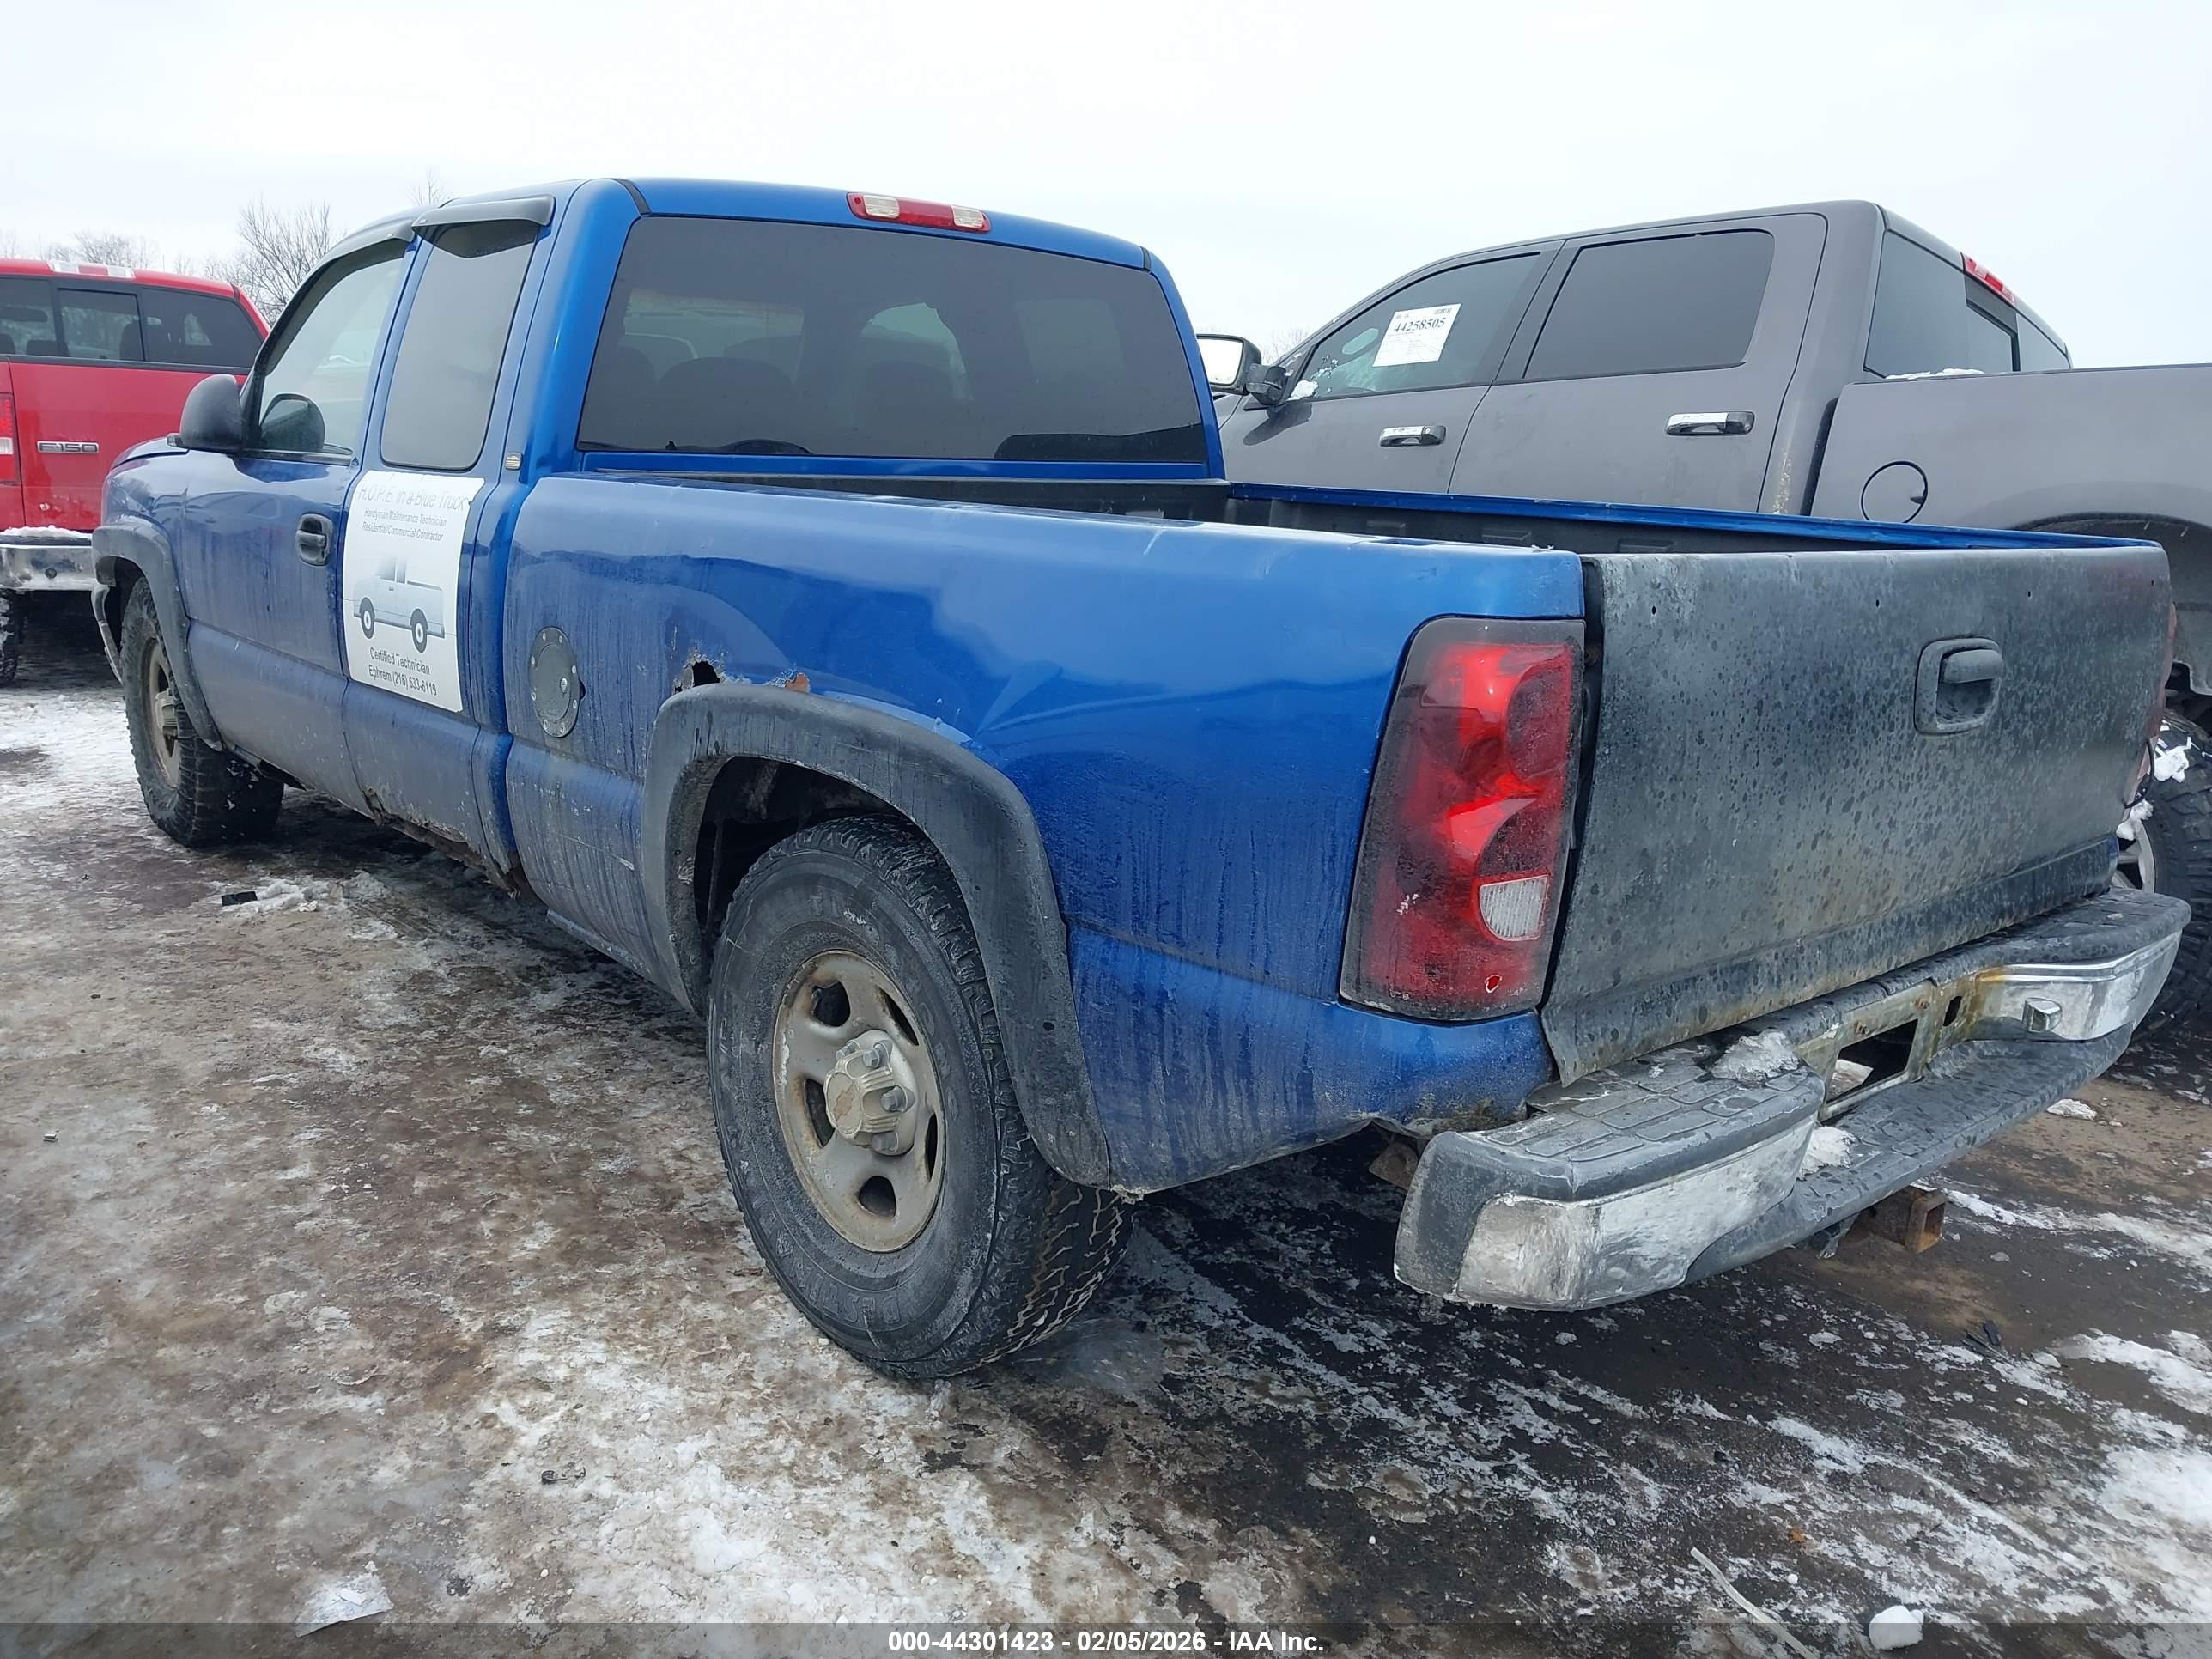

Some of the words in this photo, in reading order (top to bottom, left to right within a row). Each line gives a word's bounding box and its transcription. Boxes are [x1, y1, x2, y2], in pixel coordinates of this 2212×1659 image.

[1394, 317, 1446, 332] 44258505
[38, 441, 99, 453] F-150
[416, 528, 443, 542] Contractor
[369, 647, 395, 665] Certified
[396, 653, 430, 675] Technician
[368, 665, 392, 681] Ephrem
[392, 672, 409, 690] (216)
[409, 676, 437, 696] 633-6119
